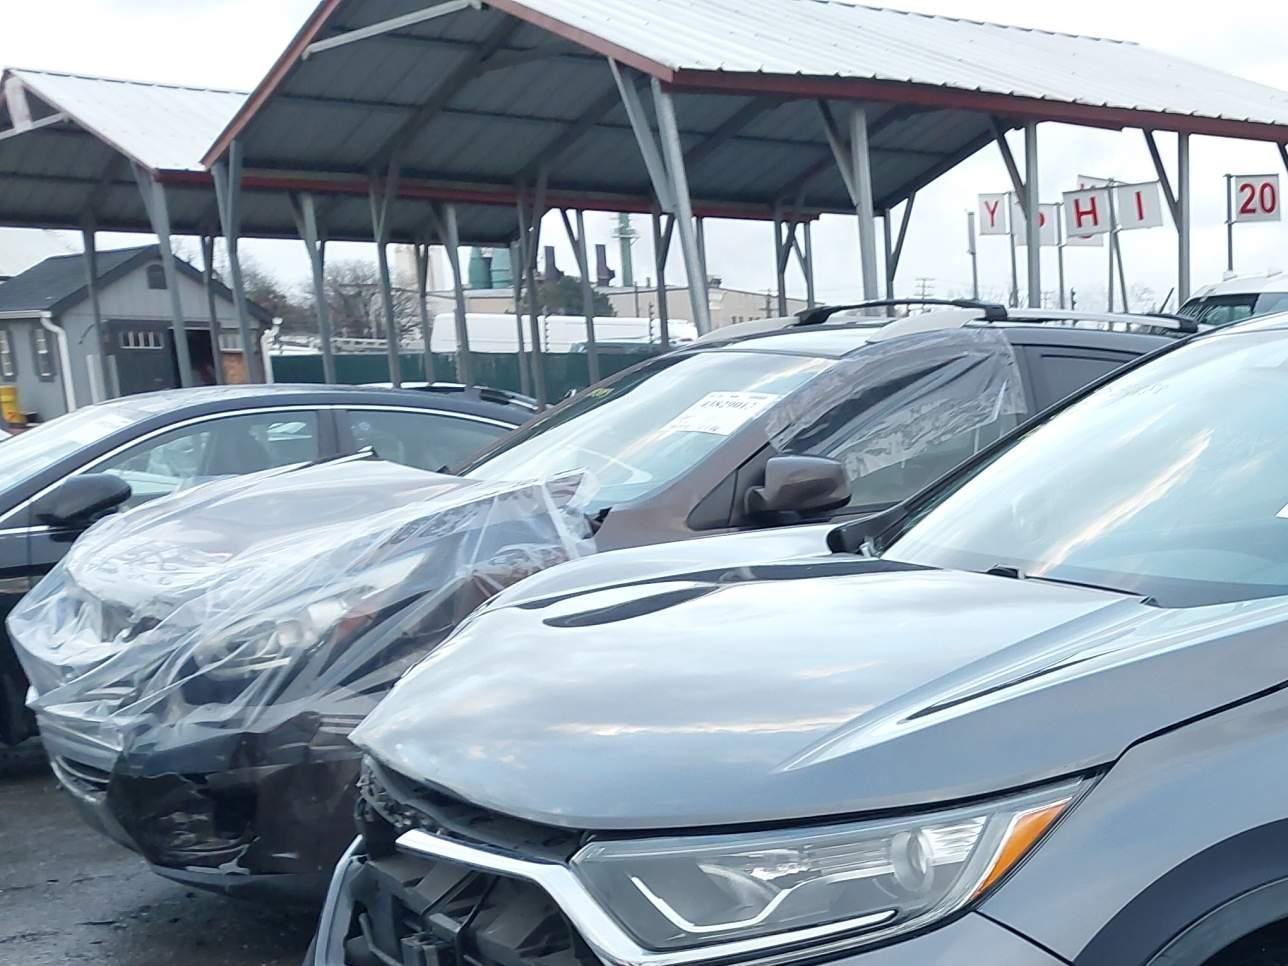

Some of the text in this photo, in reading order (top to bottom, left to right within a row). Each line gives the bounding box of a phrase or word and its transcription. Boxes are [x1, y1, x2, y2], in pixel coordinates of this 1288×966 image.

[984, 200, 999, 228] Y
[1074, 196, 1099, 228] H
[1135, 191, 1145, 221] I
[1239, 182, 1276, 215] 20
